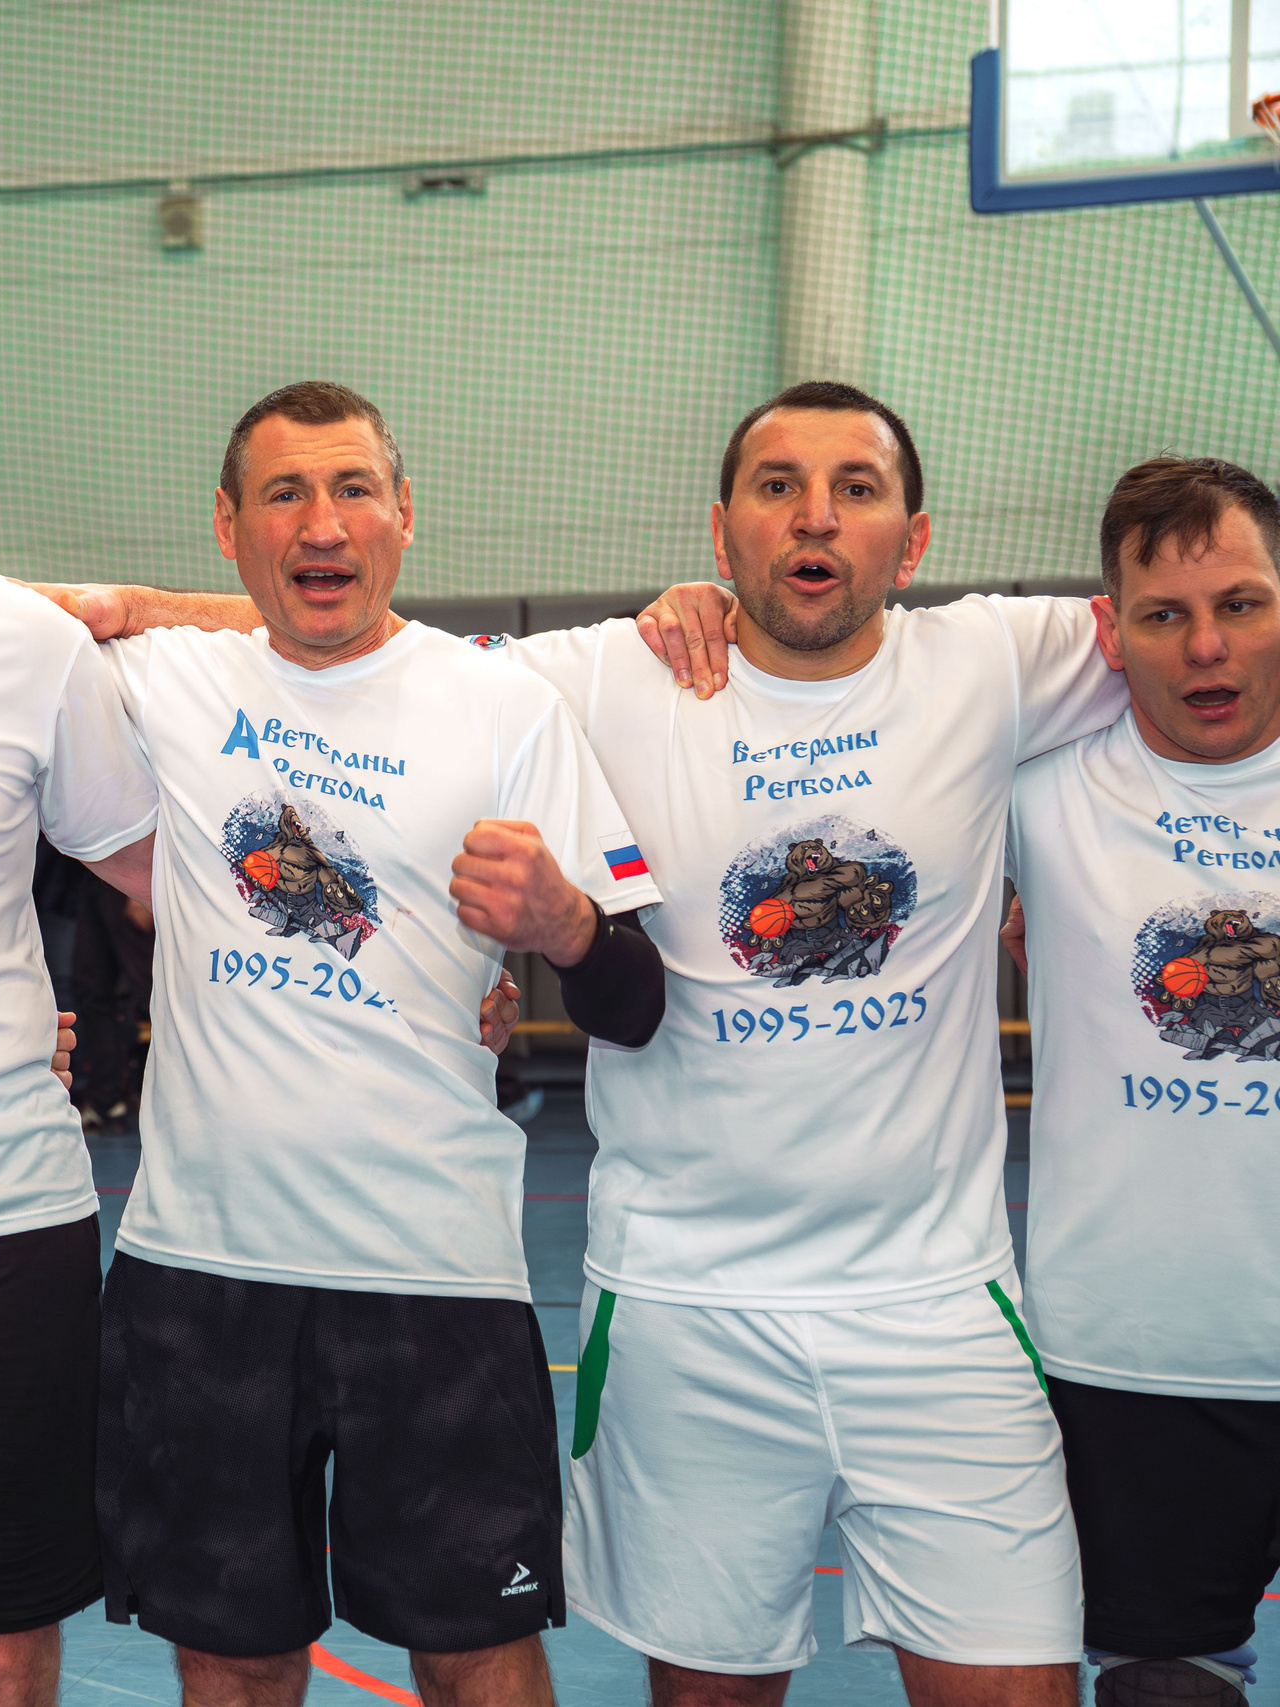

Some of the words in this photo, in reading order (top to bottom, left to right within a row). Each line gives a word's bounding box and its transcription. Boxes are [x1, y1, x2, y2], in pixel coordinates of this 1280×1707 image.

[732, 730, 878, 765] Ветераны
[743, 770, 872, 801] Регбола
[712, 985, 927, 1043] 1995-2025
[501, 1581, 539, 1596] DEMIX
